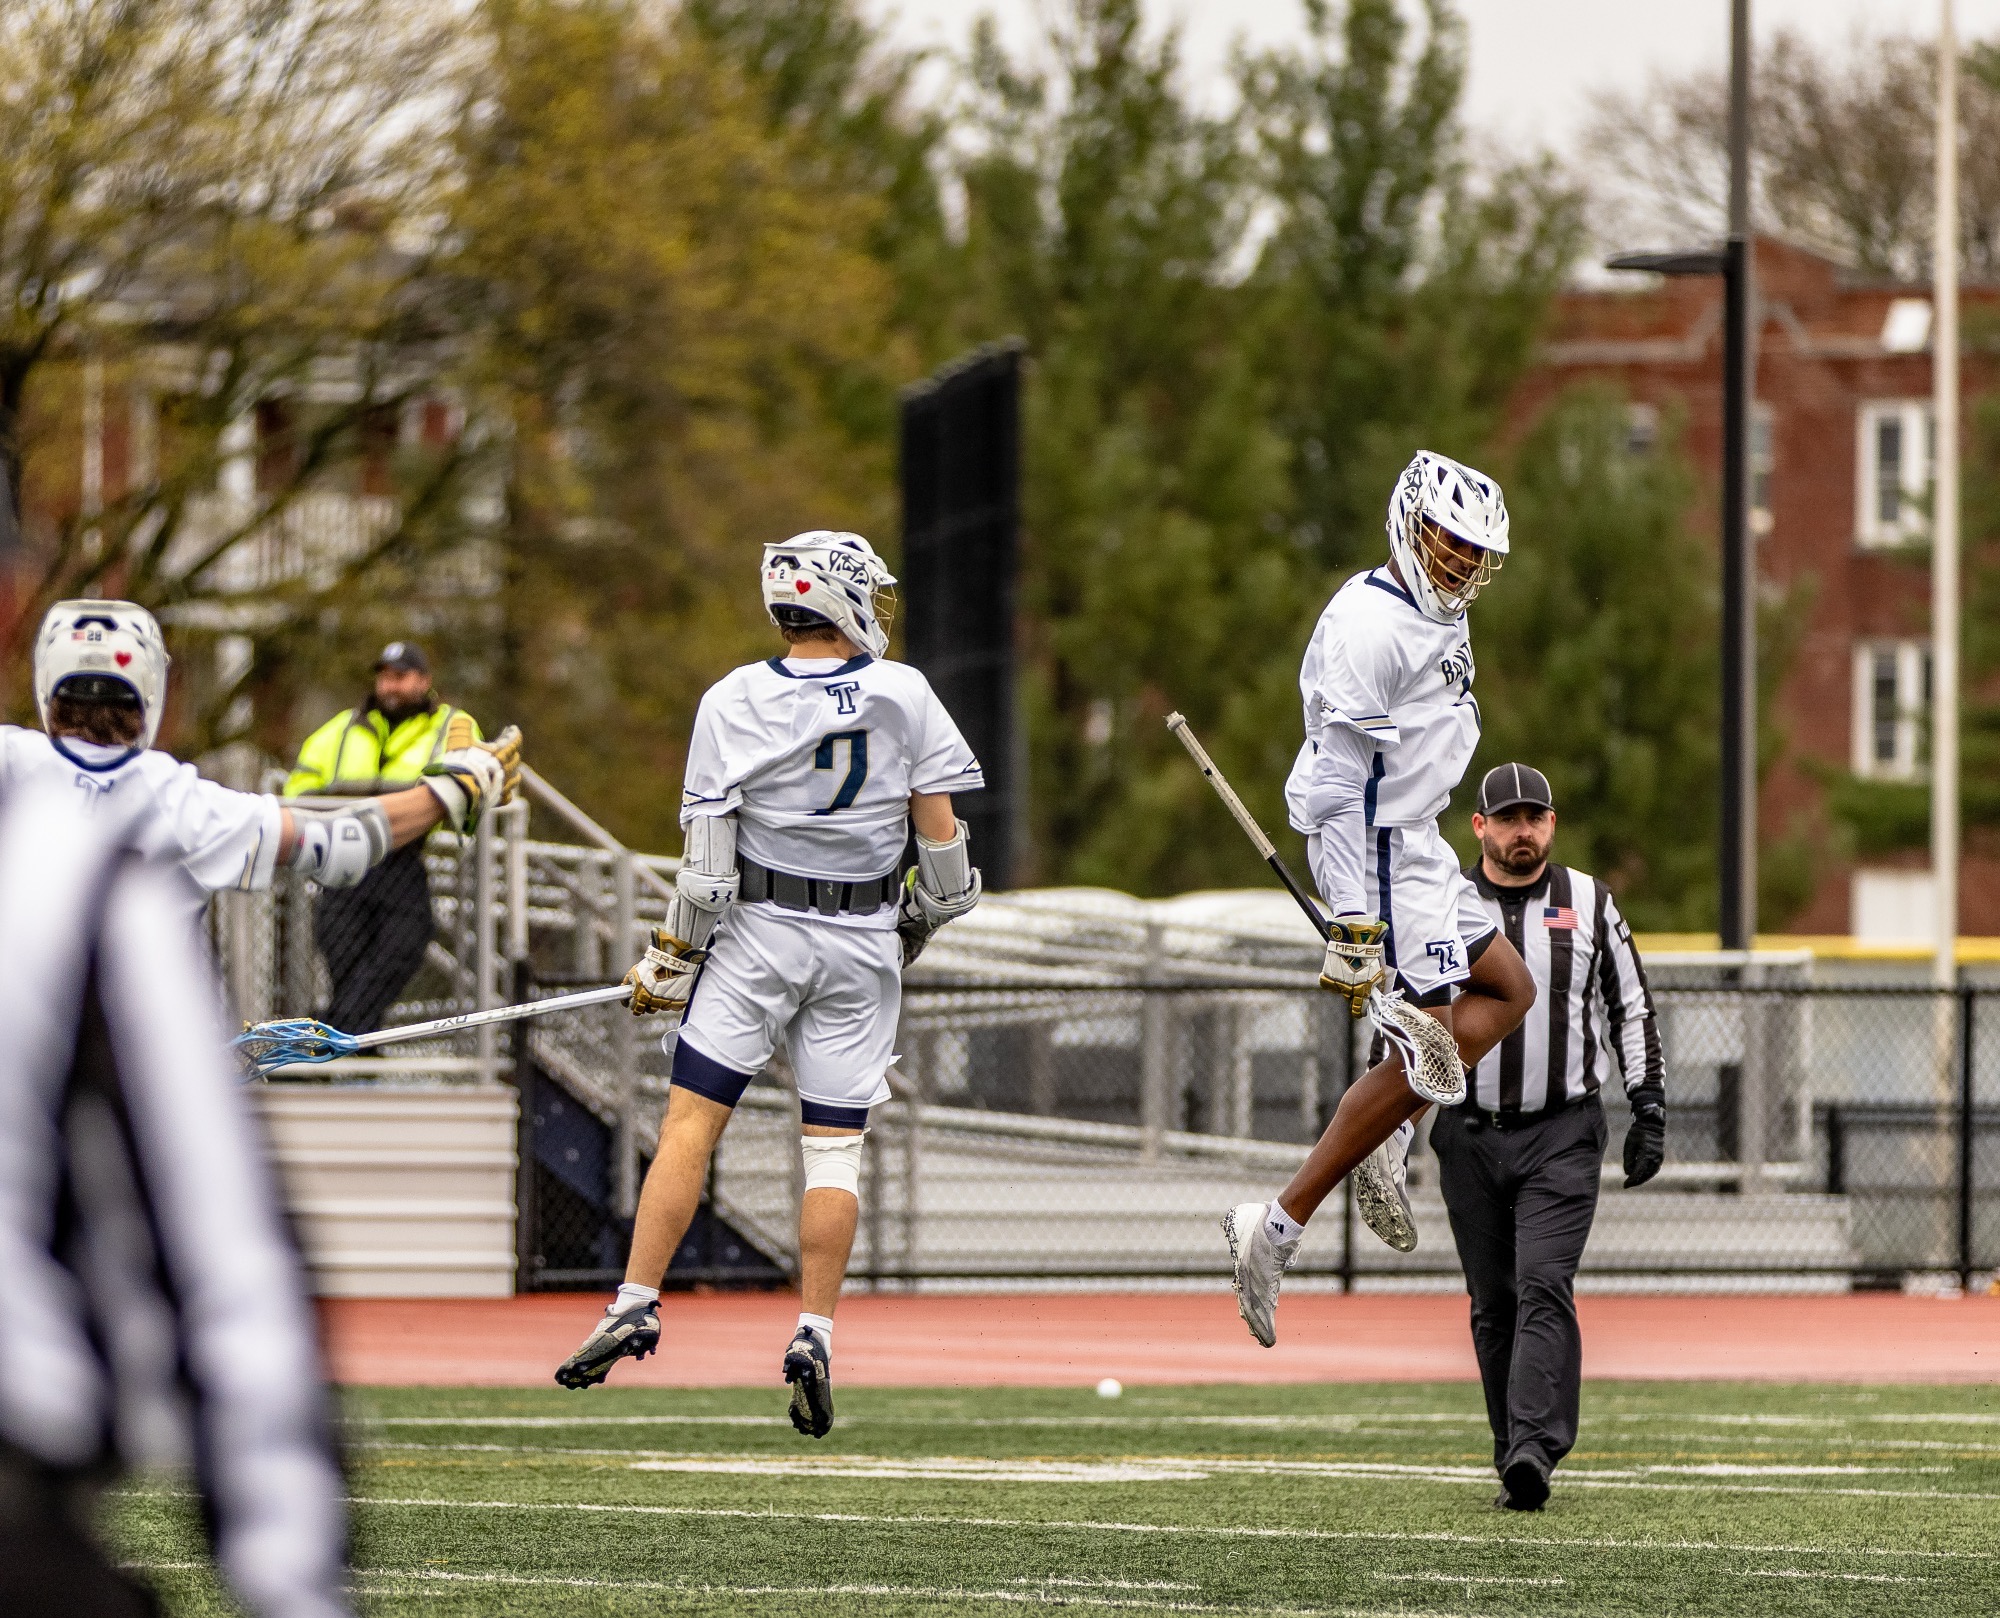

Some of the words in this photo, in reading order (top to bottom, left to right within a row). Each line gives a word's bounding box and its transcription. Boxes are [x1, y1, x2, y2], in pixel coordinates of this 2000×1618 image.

[779, 569, 785, 580] 2
[87, 630, 102, 641] 28
[824, 681, 860, 715] T
[1425, 940, 1460, 974] T
